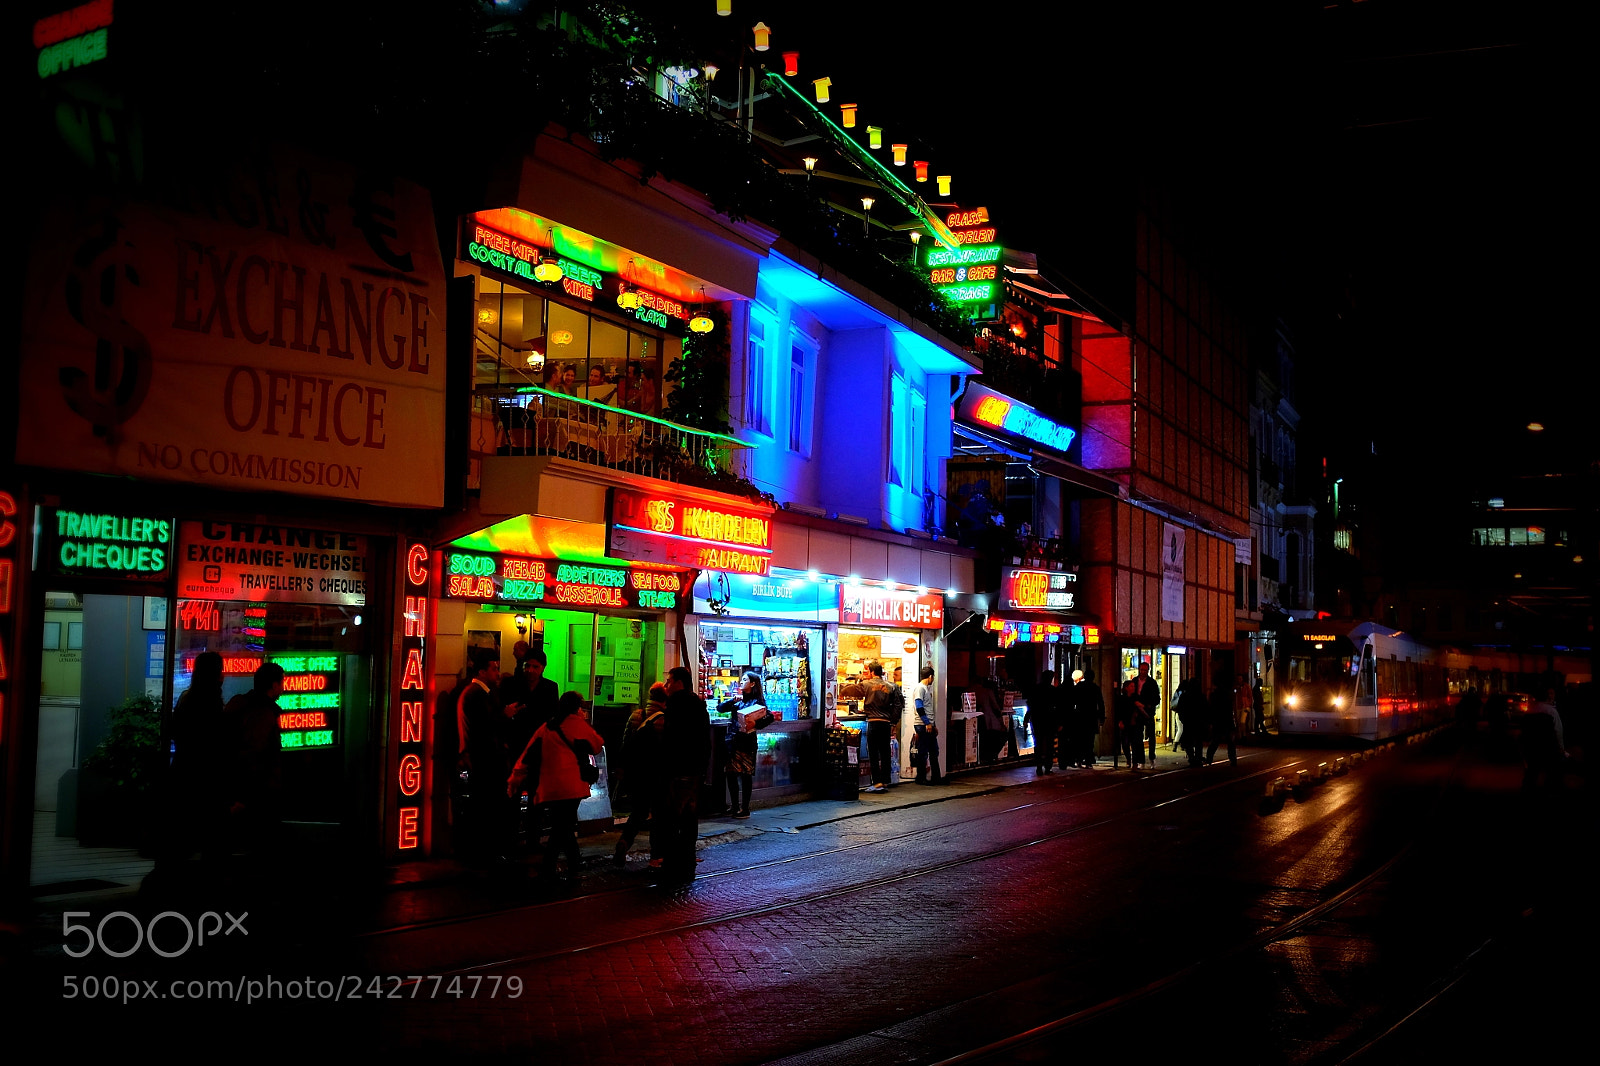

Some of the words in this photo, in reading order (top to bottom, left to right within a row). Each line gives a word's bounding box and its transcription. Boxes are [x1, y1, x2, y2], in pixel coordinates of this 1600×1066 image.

[38, 27, 108, 79] OFFICE
[475, 226, 510, 254] FREE
[511, 241, 538, 265] WIFI
[469, 241, 542, 283] COCKTAIL
[558, 259, 602, 289] BEER
[931, 270, 956, 283] BAR
[956, 267, 966, 281] &
[967, 265, 996, 280] CAFE
[563, 277, 593, 301] WINE
[172, 240, 430, 375] EXCHANGE
[223, 366, 387, 449] OFFICE
[137, 441, 183, 470] NO
[190, 448, 362, 490] COMMISSION
[56, 510, 169, 543] TRAVELLER'S
[202, 520, 357, 551] CHANGE
[685, 507, 769, 547] KARDELEN
[60, 541, 165, 571] CHEQUES
[187, 544, 368, 572] EXCHANGE-WECHSEL
[450, 554, 496, 577] SOUP
[503, 559, 546, 581] KEBAB
[556, 564, 626, 588] APPETIZERS
[186, 584, 235, 595] eurocheque
[240, 573, 314, 592] TRAVELLER'S
[319, 577, 368, 594] CHEQUES
[450, 576, 494, 598] SALAD
[503, 579, 545, 600] PIZZA
[556, 584, 622, 606] CASSEROLE
[633, 572, 652, 590] SEA
[653, 574, 681, 591] FOOD
[902, 598, 931, 624] BÜFE
[283, 674, 325, 691] KAMBİYO
[398, 544, 428, 849] CHANGE
[279, 713, 327, 729] WECHSEL
